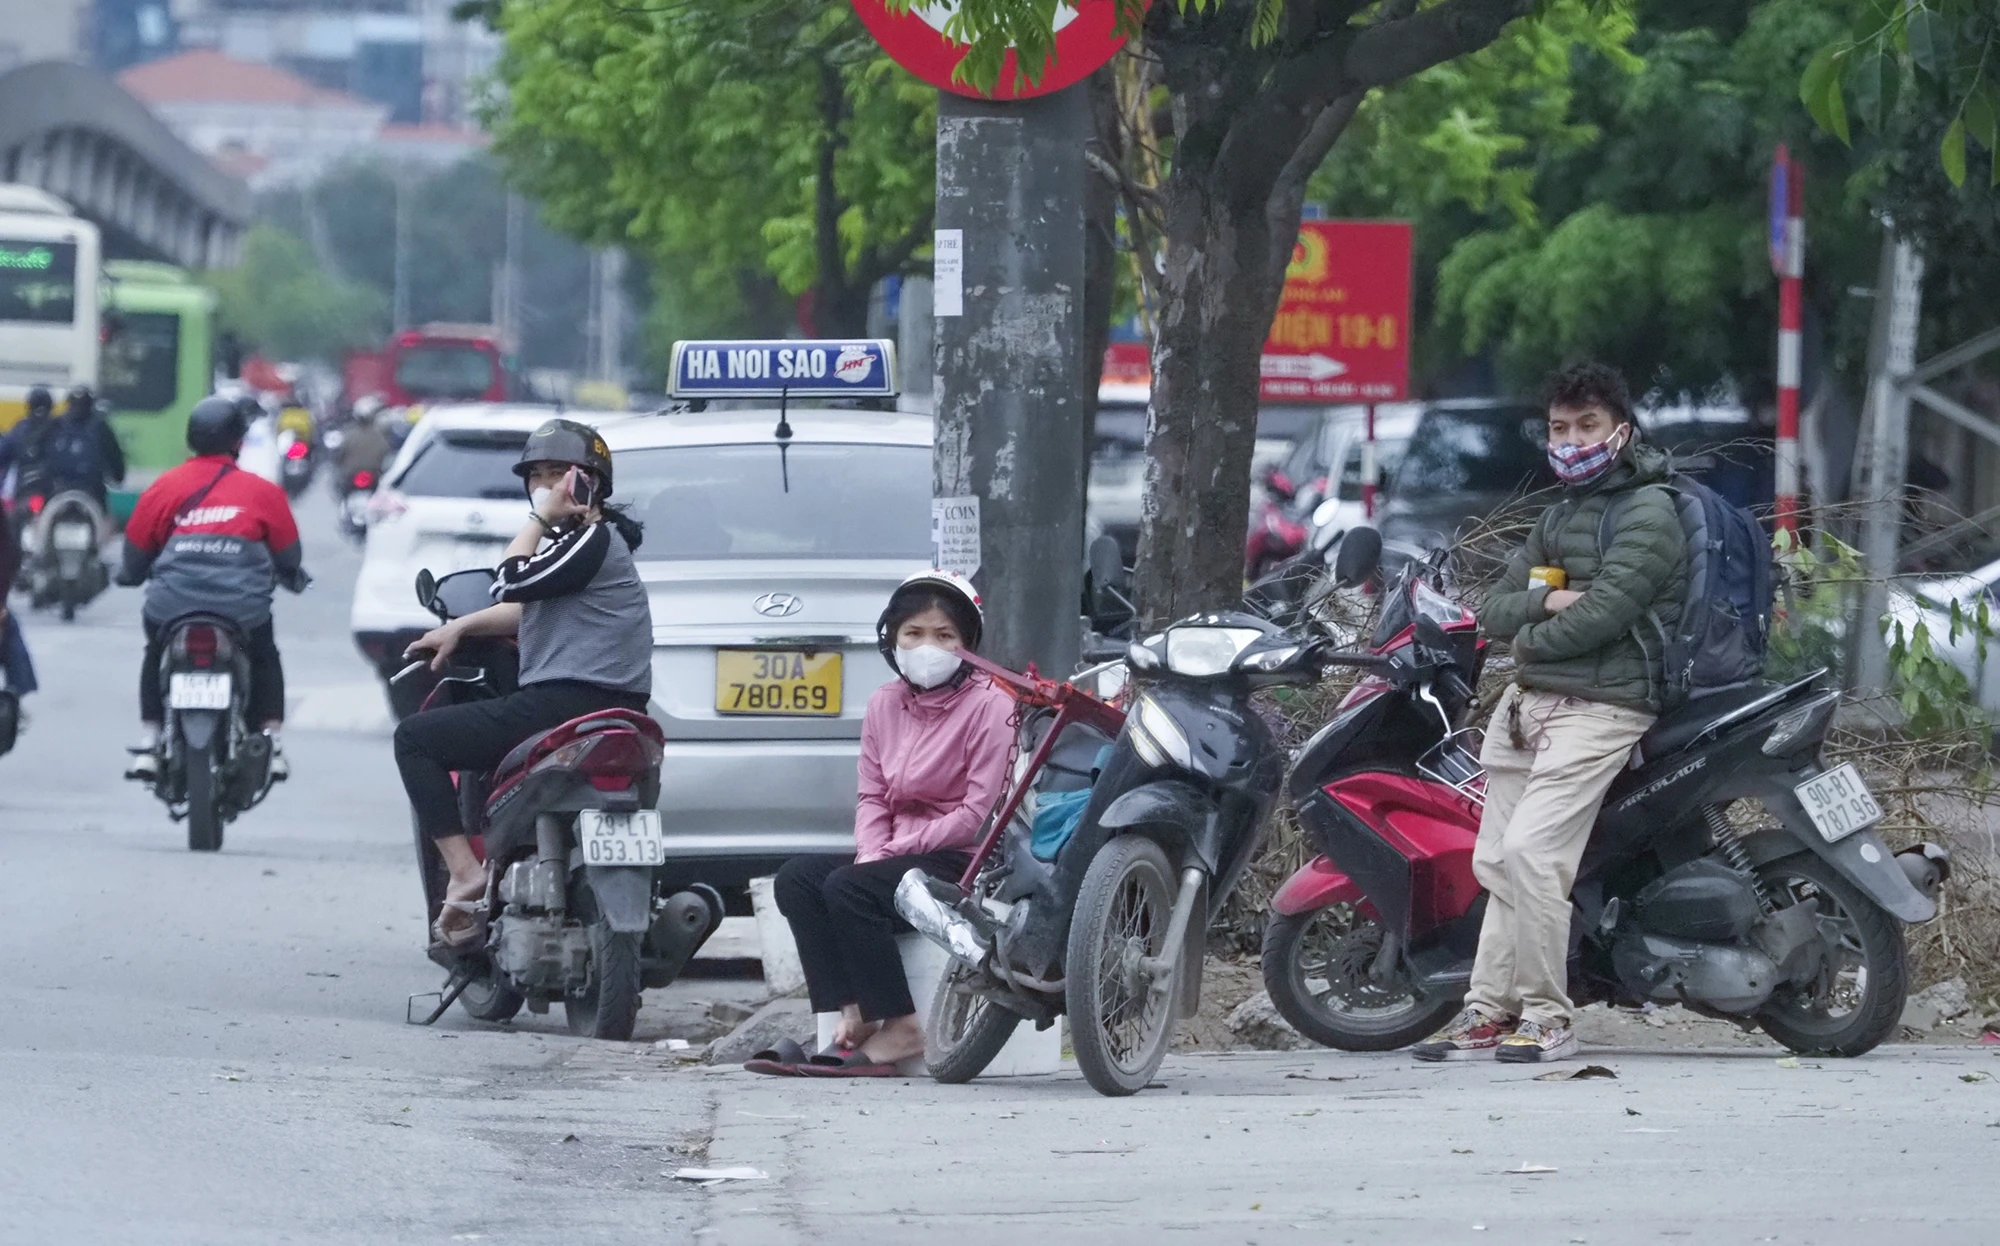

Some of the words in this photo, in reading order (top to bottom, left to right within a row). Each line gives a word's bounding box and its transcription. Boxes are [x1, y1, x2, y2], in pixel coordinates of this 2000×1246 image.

[687, 351, 720, 379] HA
[728, 349, 769, 379] NOI
[778, 349, 827, 379] SAO
[944, 505, 977, 520] CCMN
[753, 654, 805, 680] 30A
[729, 683, 828, 710] 780.69
[1649, 756, 1707, 793] BLADE
[1806, 770, 1856, 809] 90-B1
[593, 814, 648, 837] 29-L1
[1816, 793, 1877, 837] 787.96
[589, 839, 658, 862] 053.13
